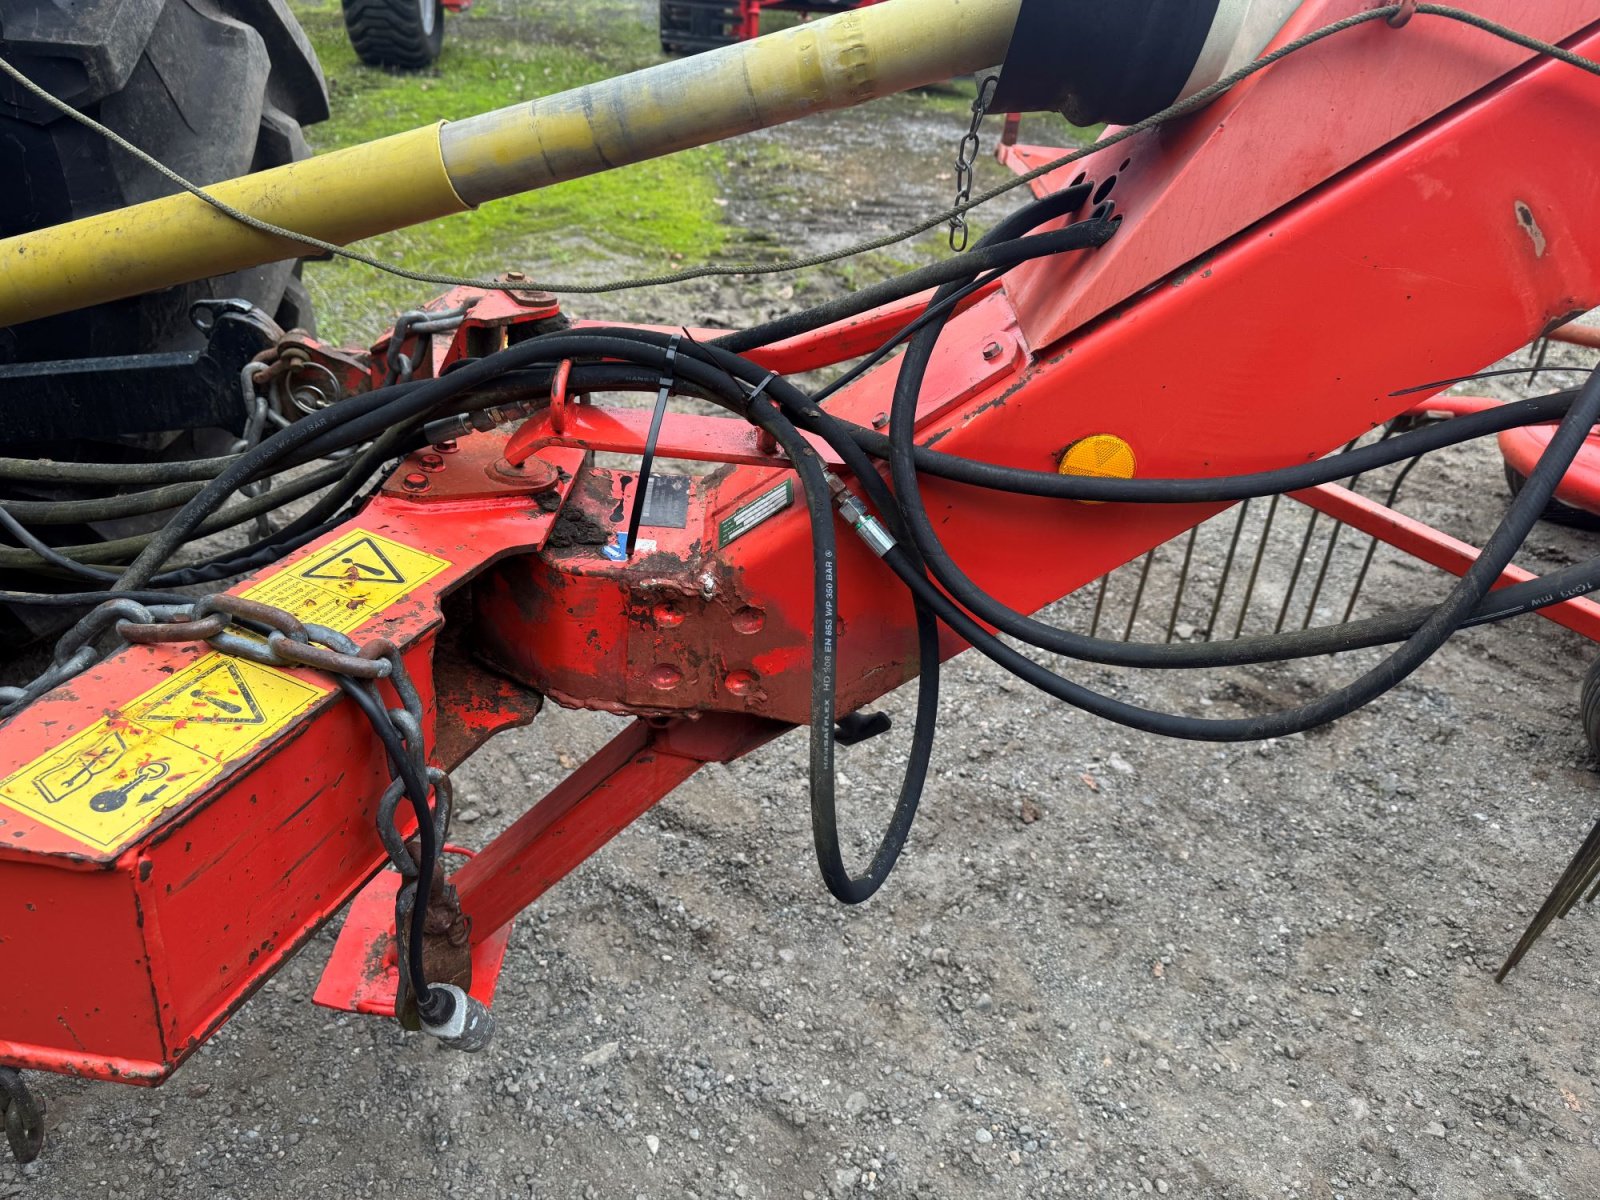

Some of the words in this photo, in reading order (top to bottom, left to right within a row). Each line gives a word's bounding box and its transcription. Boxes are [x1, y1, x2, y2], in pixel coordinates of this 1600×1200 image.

[307, 415, 328, 433] BAR
[825, 561, 833, 581] BAR
[825, 582, 833, 599] 350
[825, 600, 833, 616] WP
[825, 619, 833, 636] 853
[824, 638, 832, 653] EN
[823, 675, 831, 691] HD
